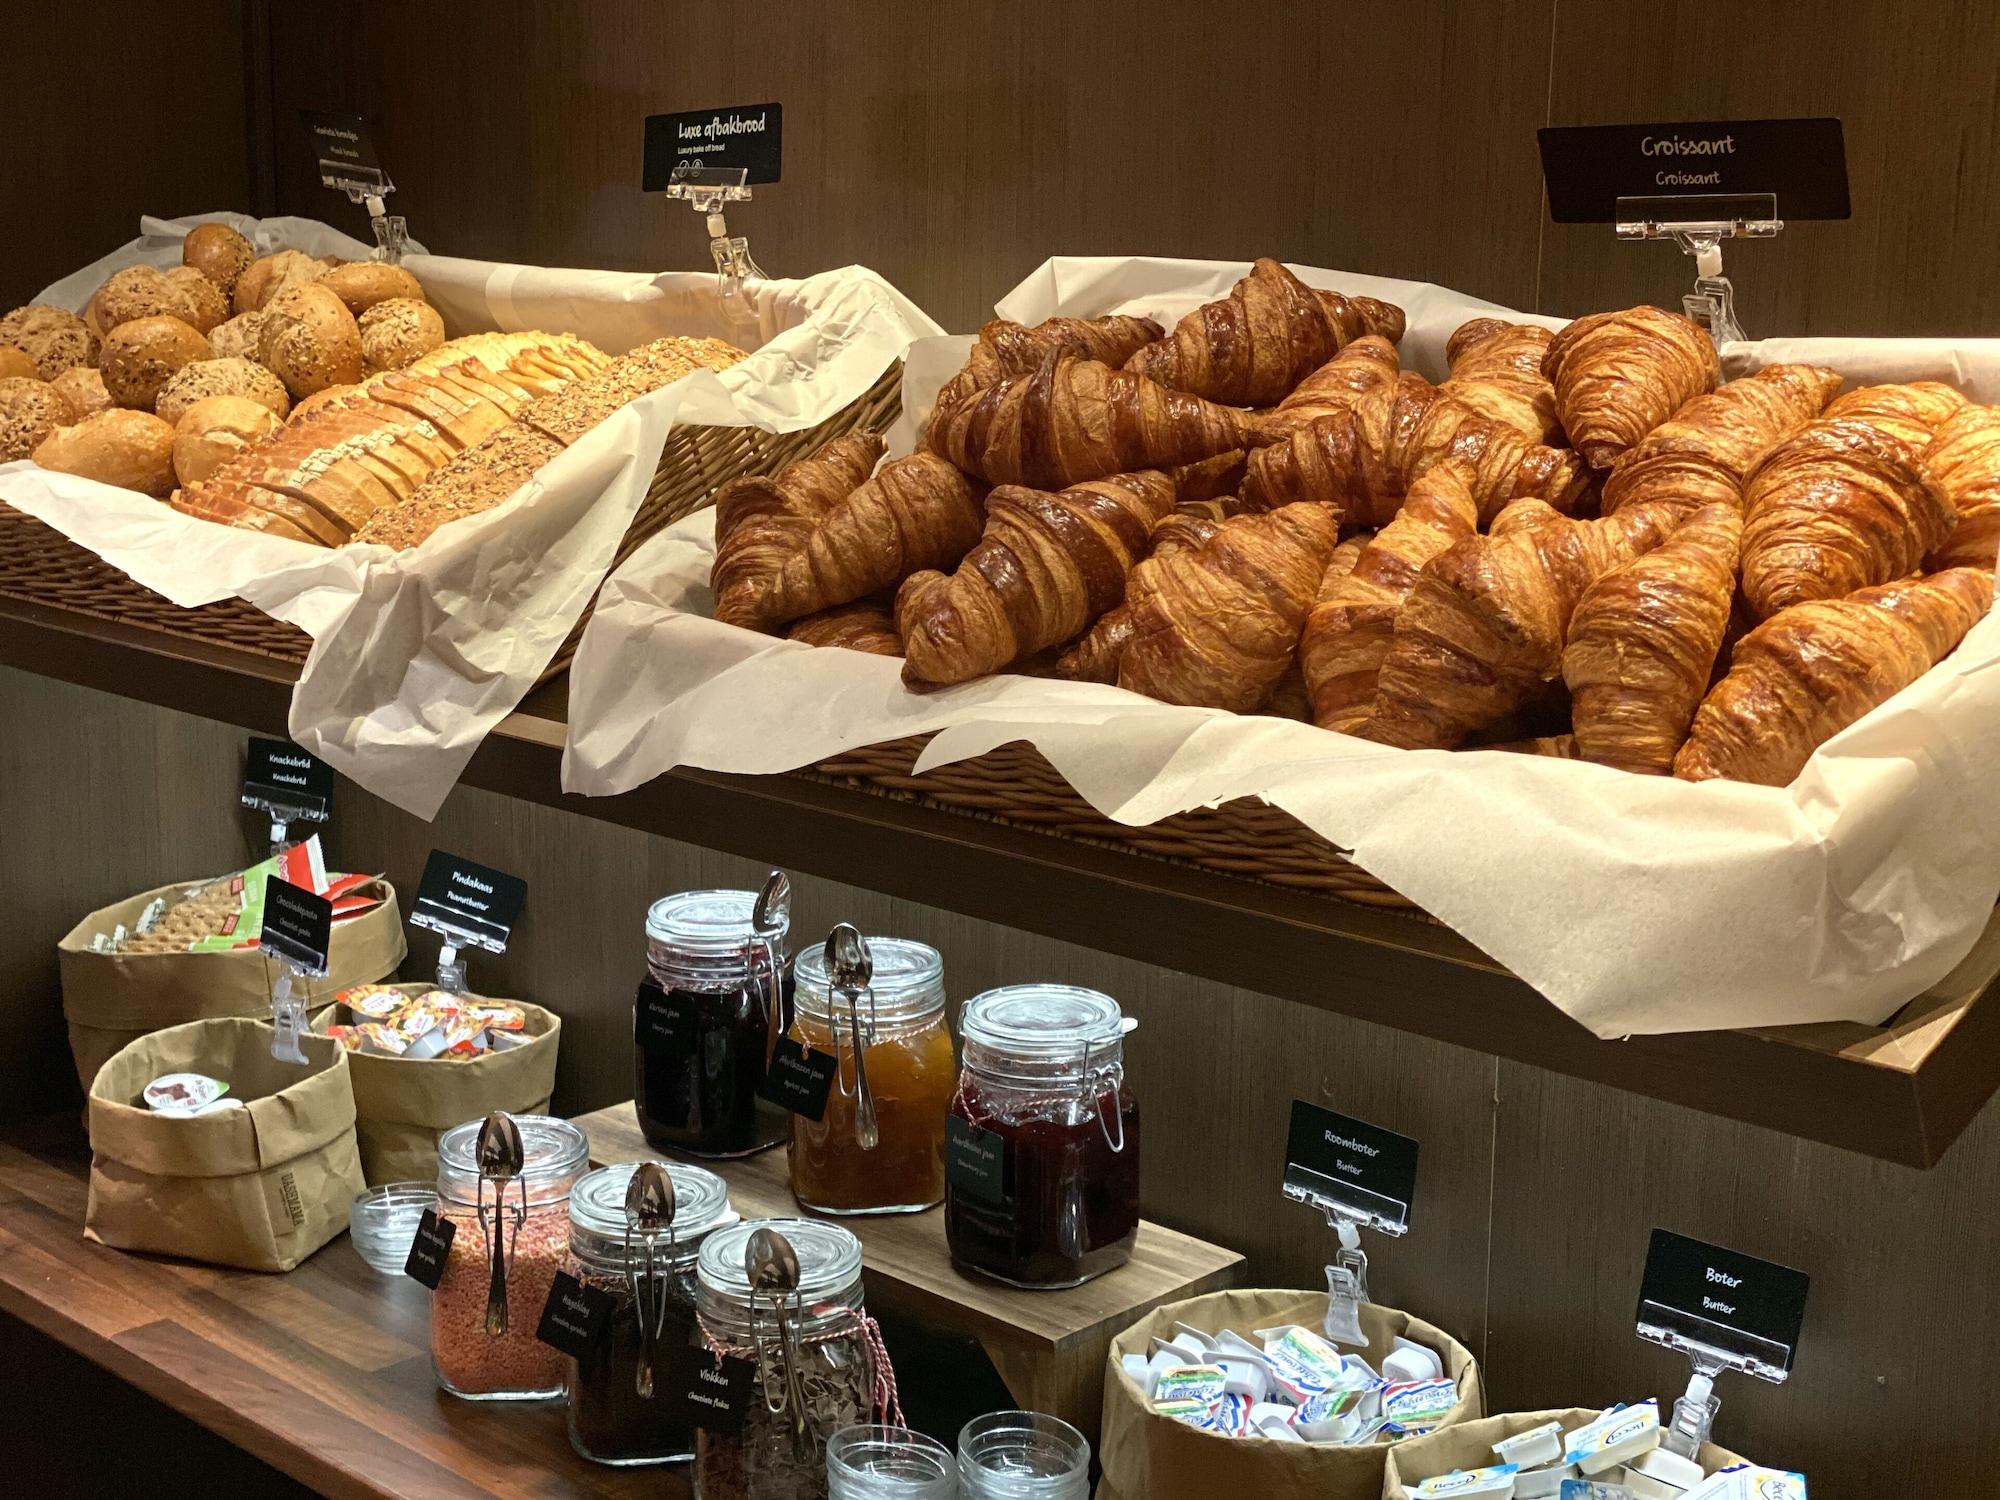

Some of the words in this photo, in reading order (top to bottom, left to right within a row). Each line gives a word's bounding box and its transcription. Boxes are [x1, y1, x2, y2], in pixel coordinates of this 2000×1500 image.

[678, 122, 702, 139] Luxe
[704, 112, 766, 141] afbakbrood
[1641, 135, 1736, 156] Croissant
[1655, 170, 1721, 185] Croissant
[452, 871, 494, 894] Pindakaas
[446, 890, 490, 911] Peanutbutter
[1325, 1130, 1380, 1157] Roomboter
[1336, 1159, 1363, 1176] Butter
[1706, 1267, 1742, 1288] Boter
[1703, 1296, 1736, 1315] Butter
[700, 1369, 729, 1387] Vlokken
